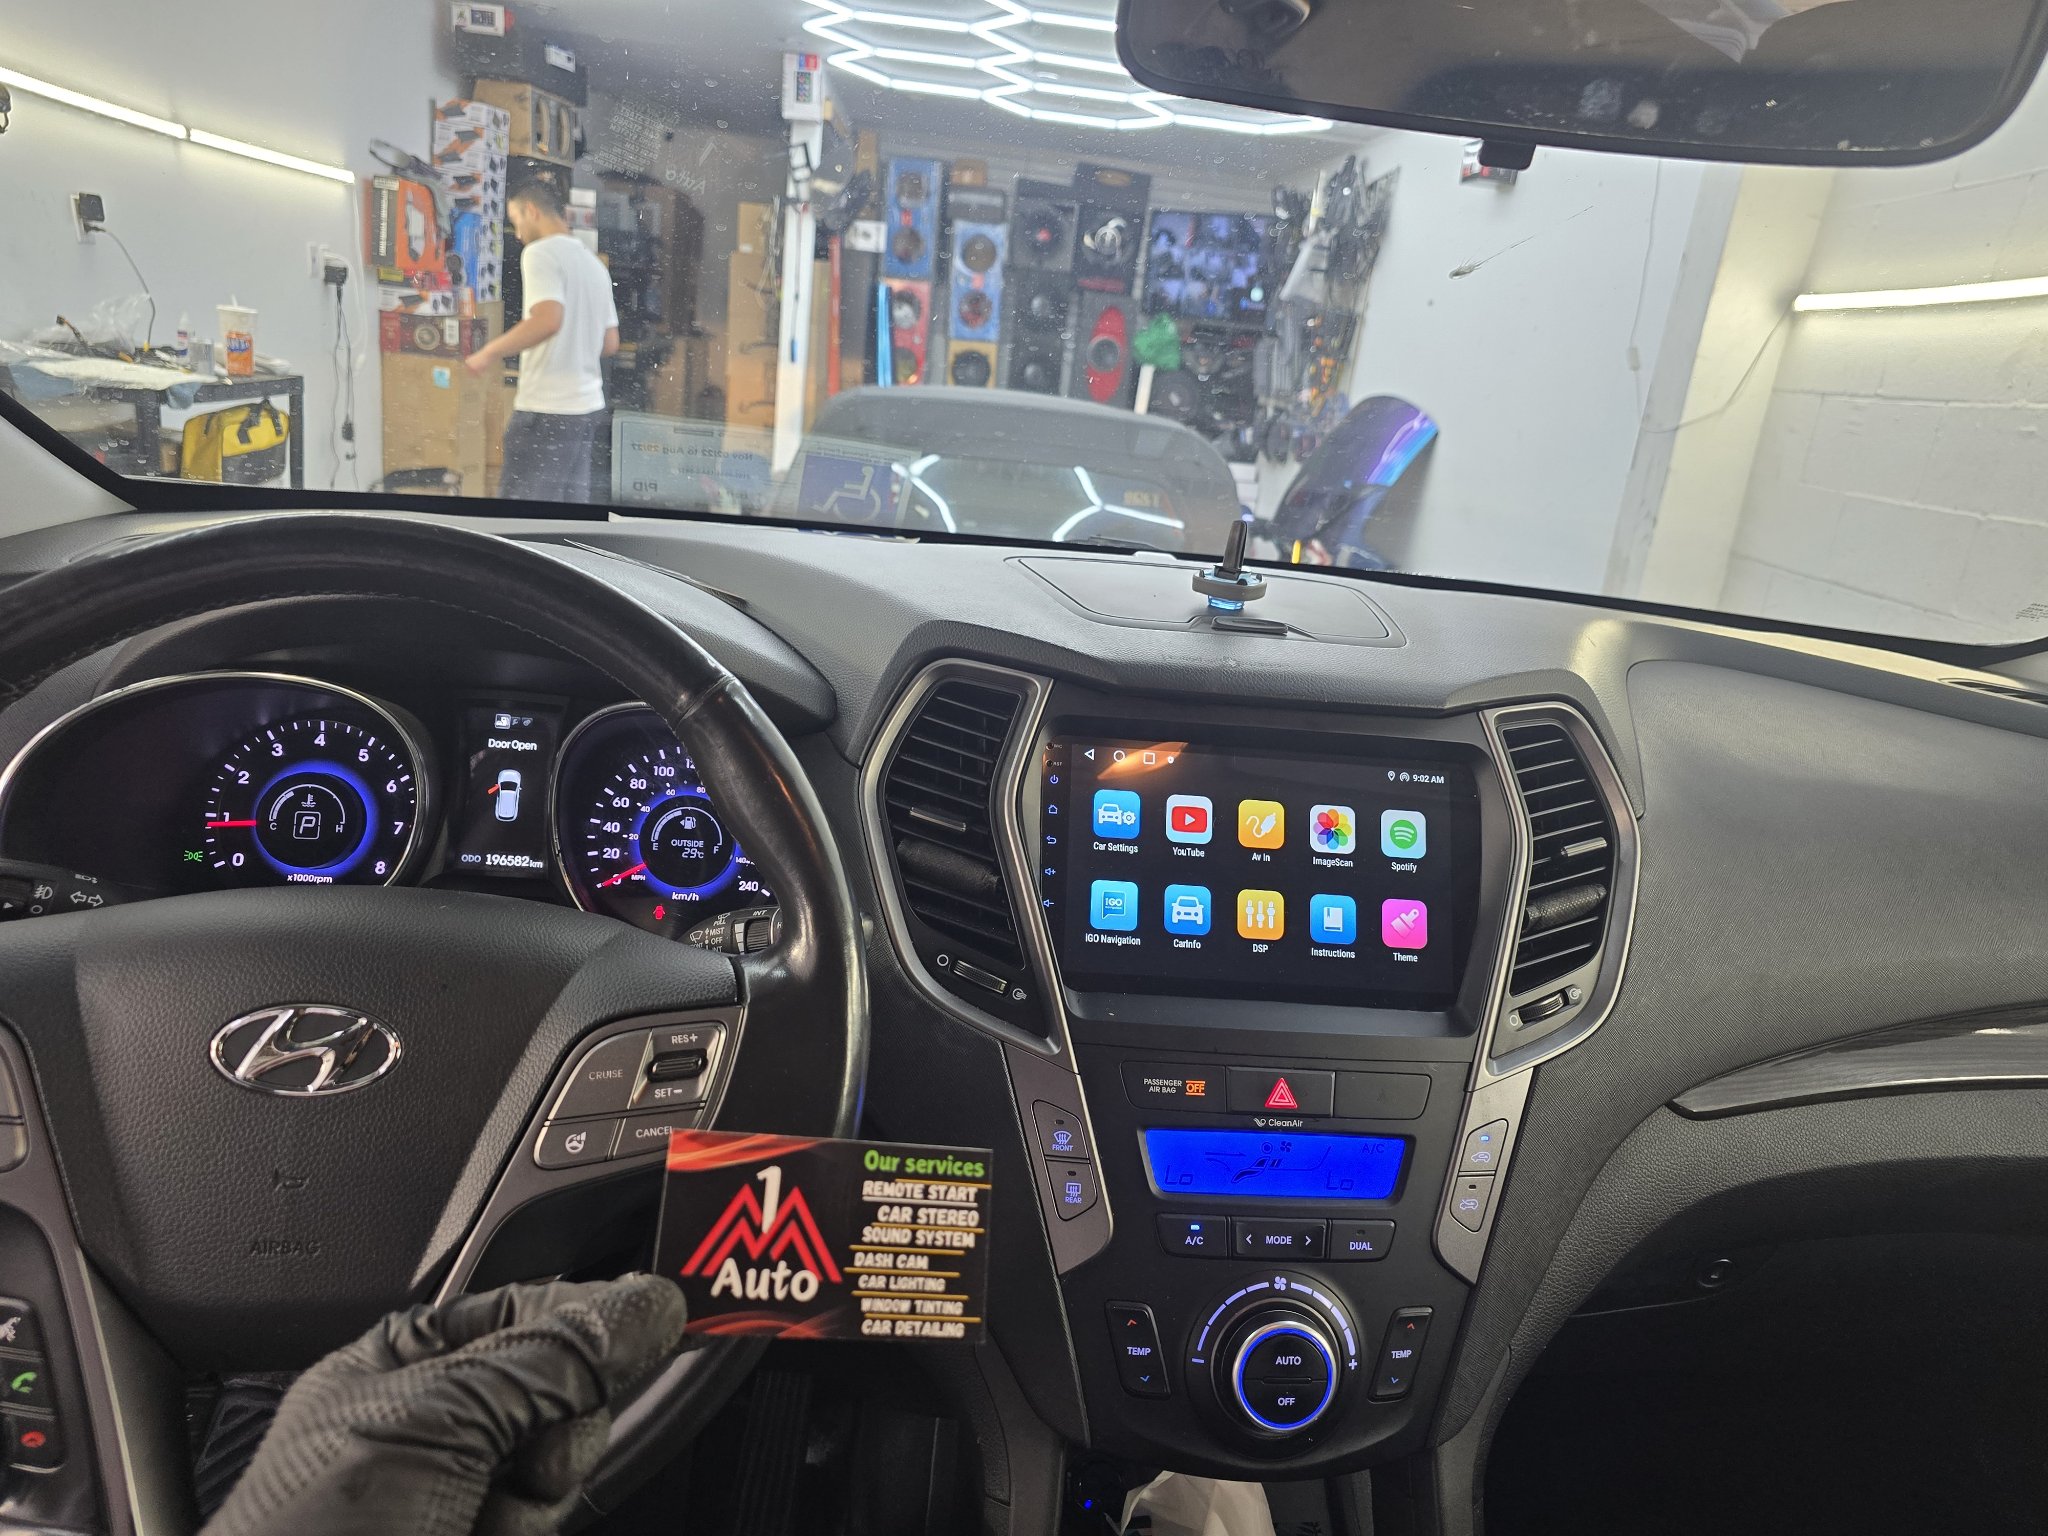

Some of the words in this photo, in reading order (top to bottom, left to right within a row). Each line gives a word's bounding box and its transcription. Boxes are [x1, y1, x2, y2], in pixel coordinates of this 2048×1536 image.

[314, 733, 326, 747] 4
[488, 738, 510, 750] Door
[511, 740, 537, 752] Open
[272, 743, 284, 757] 3
[358, 748, 370, 763] 5
[653, 765, 675, 777] 100
[238, 770, 250, 785] 2
[1413, 774, 1430, 783] 9:02
[1431, 775, 1445, 784] AM
[386, 780, 397, 793] 6
[630, 779, 647, 790] 80
[612, 797, 630, 808] 60
[640, 805, 650, 813] 40
[299, 815, 316, 834] P
[394, 821, 404, 835] 7
[603, 822, 620, 833] 40
[671, 839, 704, 848] OUTSIDE
[1093, 841, 1107, 851] Car
[1108, 842, 1139, 854] Settings
[602, 848, 620, 859] 20
[1172, 847, 1205, 858] YouTube
[1252, 853, 1262, 862] Av
[232, 853, 244, 867] 0
[461, 854, 482, 863] ODO
[1312, 857, 1354, 869] ImageScan
[375, 861, 386, 875] 8
[1391, 862, 1418, 874] Spotify
[287, 873, 333, 885] x1000rpm
[738, 881, 759, 892] 240
[671, 891, 700, 902] km/h
[709, 927, 725, 936] MIST
[710, 936, 723, 945] OFF
[1101, 934, 1141, 946] Navigation
[1173, 939, 1202, 949] CarInfo
[1252, 944, 1269, 953] DSP
[1311, 948, 1356, 959] Instructions
[1393, 953, 1418, 963] Theme
[588, 1069, 623, 1080] CRUISE
[1143, 1078, 1182, 1088] PASSENGER
[1186, 1082, 1206, 1093] OFF
[1148, 1085, 1160, 1093] AIR
[1161, 1085, 1176, 1094] BAG
[1268, 1118, 1303, 1128] CleanAir
[1052, 1143, 1073, 1152] FRONT
[864, 1149, 900, 1172] Our
[905, 1155, 985, 1178] services
[862, 1180, 925, 1199] REMOTE
[927, 1184, 978, 1202] START
[1065, 1196, 1083, 1204] REAR
[877, 1205, 913, 1223] CAR
[916, 1208, 980, 1227] STEREO
[862, 1226, 912, 1246] SOUND
[915, 1228, 975, 1248] SYSTEM
[1185, 1235, 1204, 1247] A/C
[1265, 1235, 1292, 1246] MODE
[249, 1238, 321, 1256] AIRBAG
[1349, 1241, 1373, 1252] DUAL
[854, 1252, 894, 1268] DASH
[896, 1254, 929, 1270] CAM
[710, 1257, 820, 1302] Auto
[858, 1274, 887, 1289] CAR
[888, 1276, 946, 1292] LIGHTING
[860, 1297, 911, 1313] WINDOW
[914, 1300, 964, 1315] TINTING
[861, 1319, 892, 1335] CAR
[1127, 1346, 1151, 1357] TEMP
[1391, 1350, 1412, 1360] TEMP
[1275, 1356, 1301, 1367] AUTO
[1277, 1396, 1296, 1407] OFF
